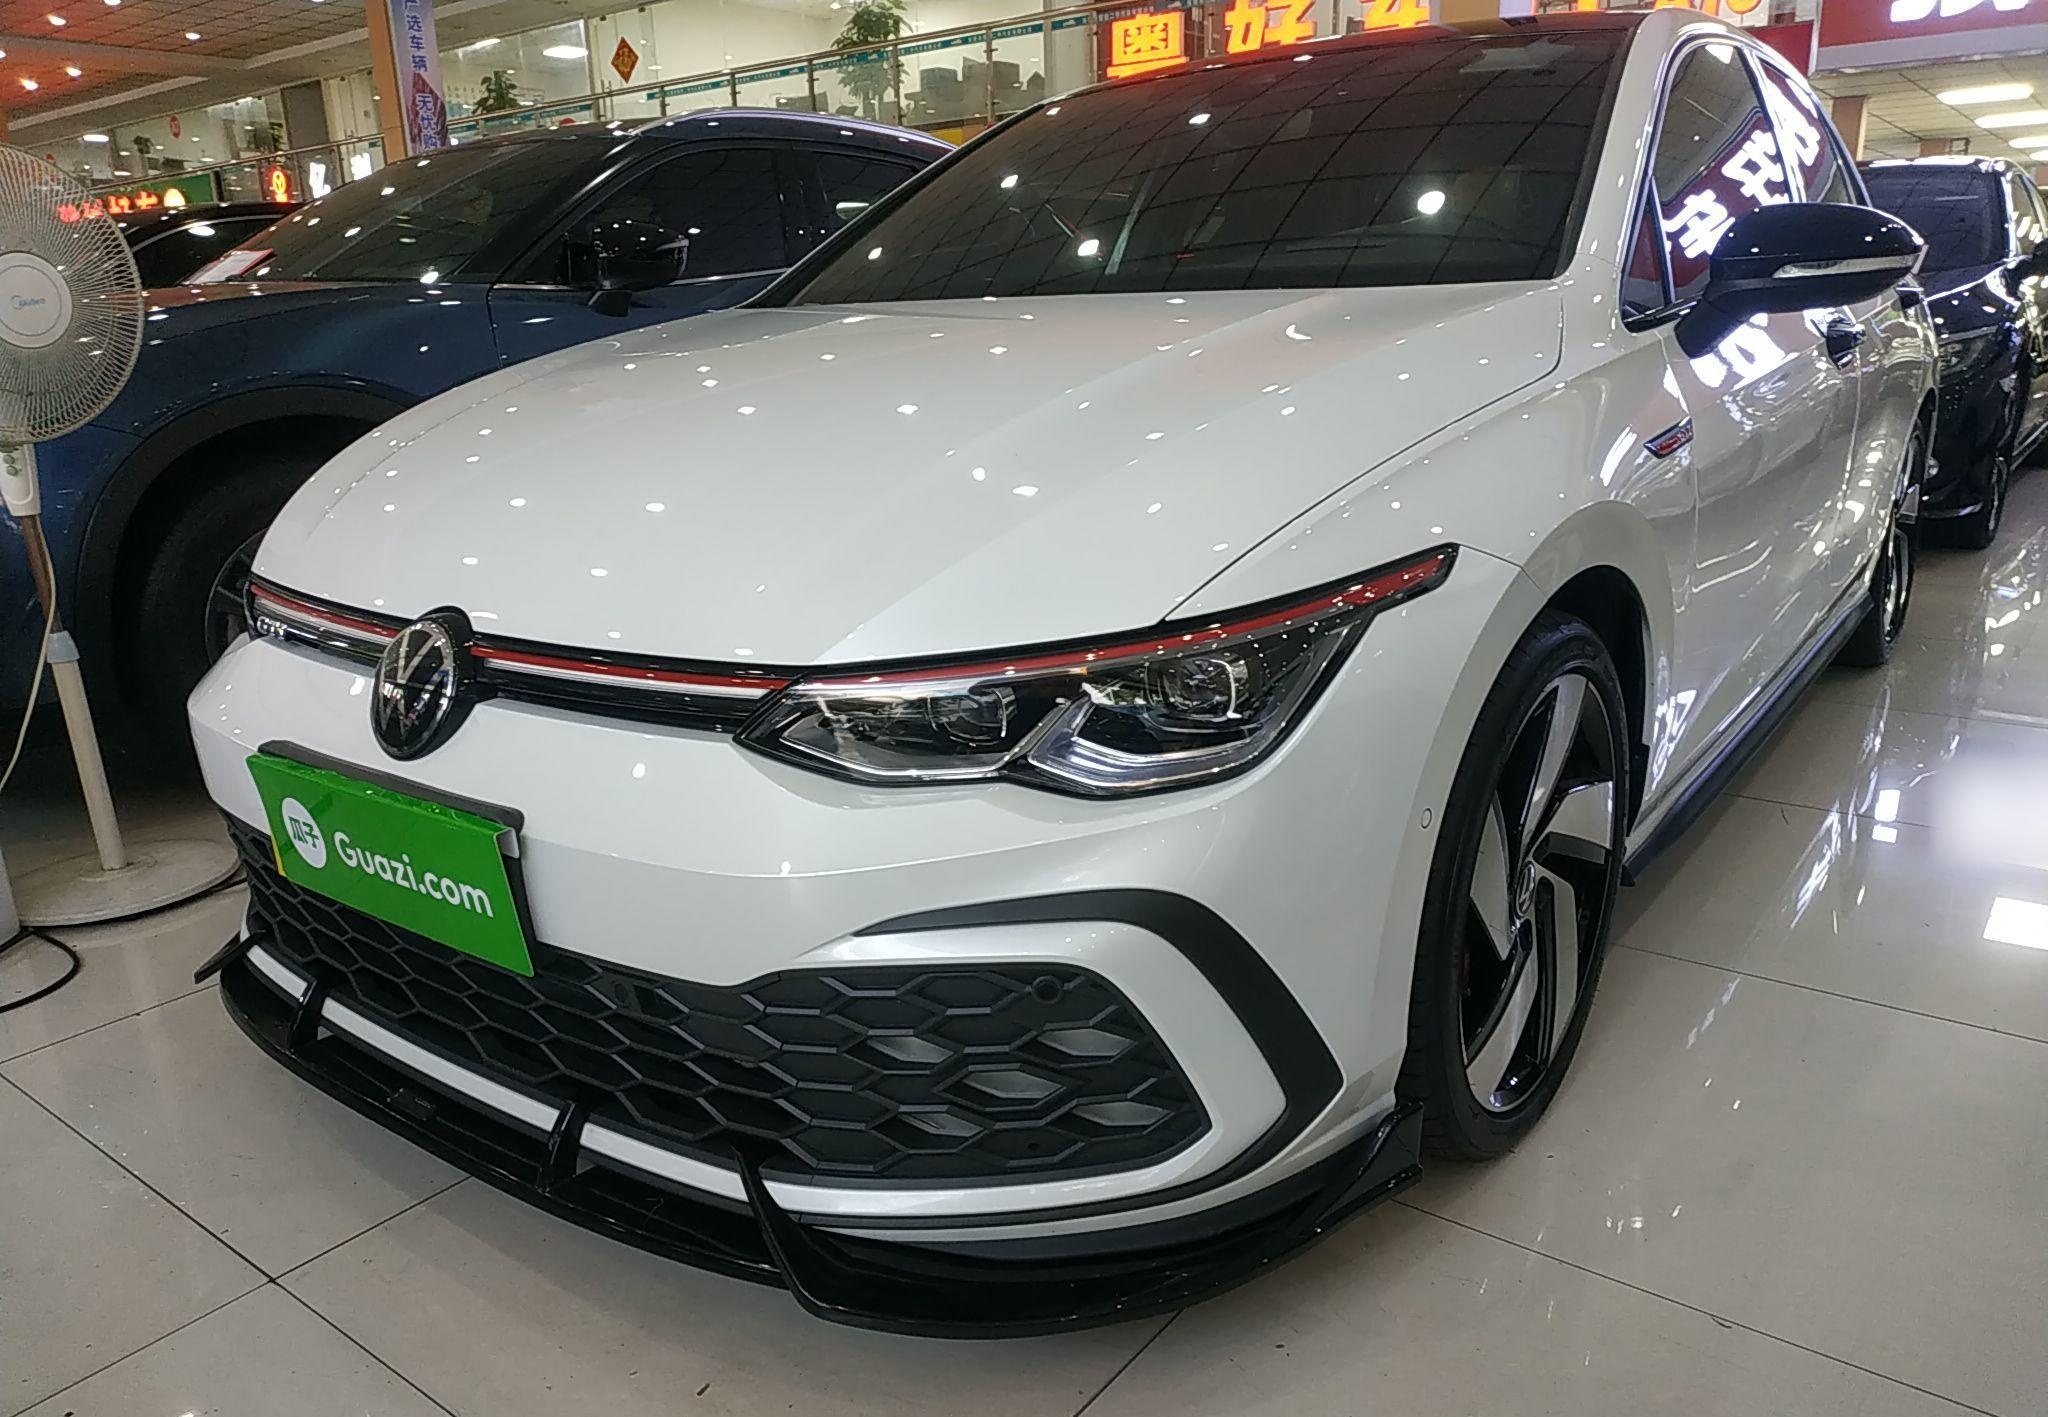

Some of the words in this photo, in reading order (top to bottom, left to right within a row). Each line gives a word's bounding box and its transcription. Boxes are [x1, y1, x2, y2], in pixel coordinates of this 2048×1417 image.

[417, 94, 438, 150] 无忧购
[288, 815, 321, 849] 瓜子
[333, 830, 494, 918] Guazi.com
